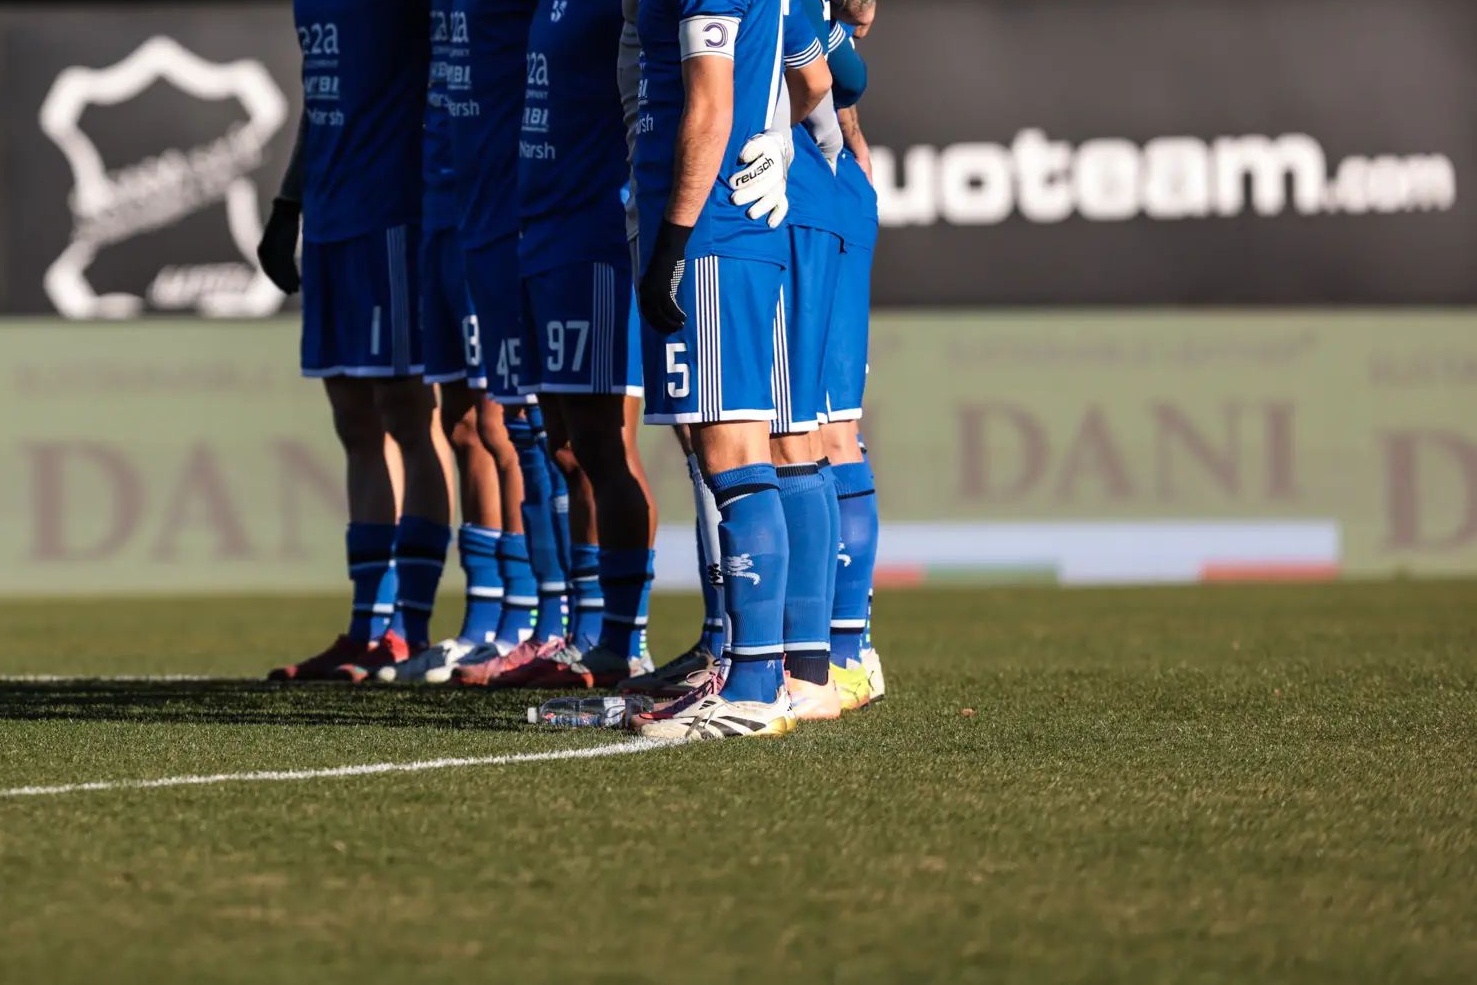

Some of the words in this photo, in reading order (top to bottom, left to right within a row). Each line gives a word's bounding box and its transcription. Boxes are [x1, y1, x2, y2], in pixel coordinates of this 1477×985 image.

[735, 157, 775, 188] reusch
[546, 320, 591, 372] 97
[665, 342, 691, 399] 5
[952, 398, 1301, 506] DANI
[18, 434, 351, 566] DAN
